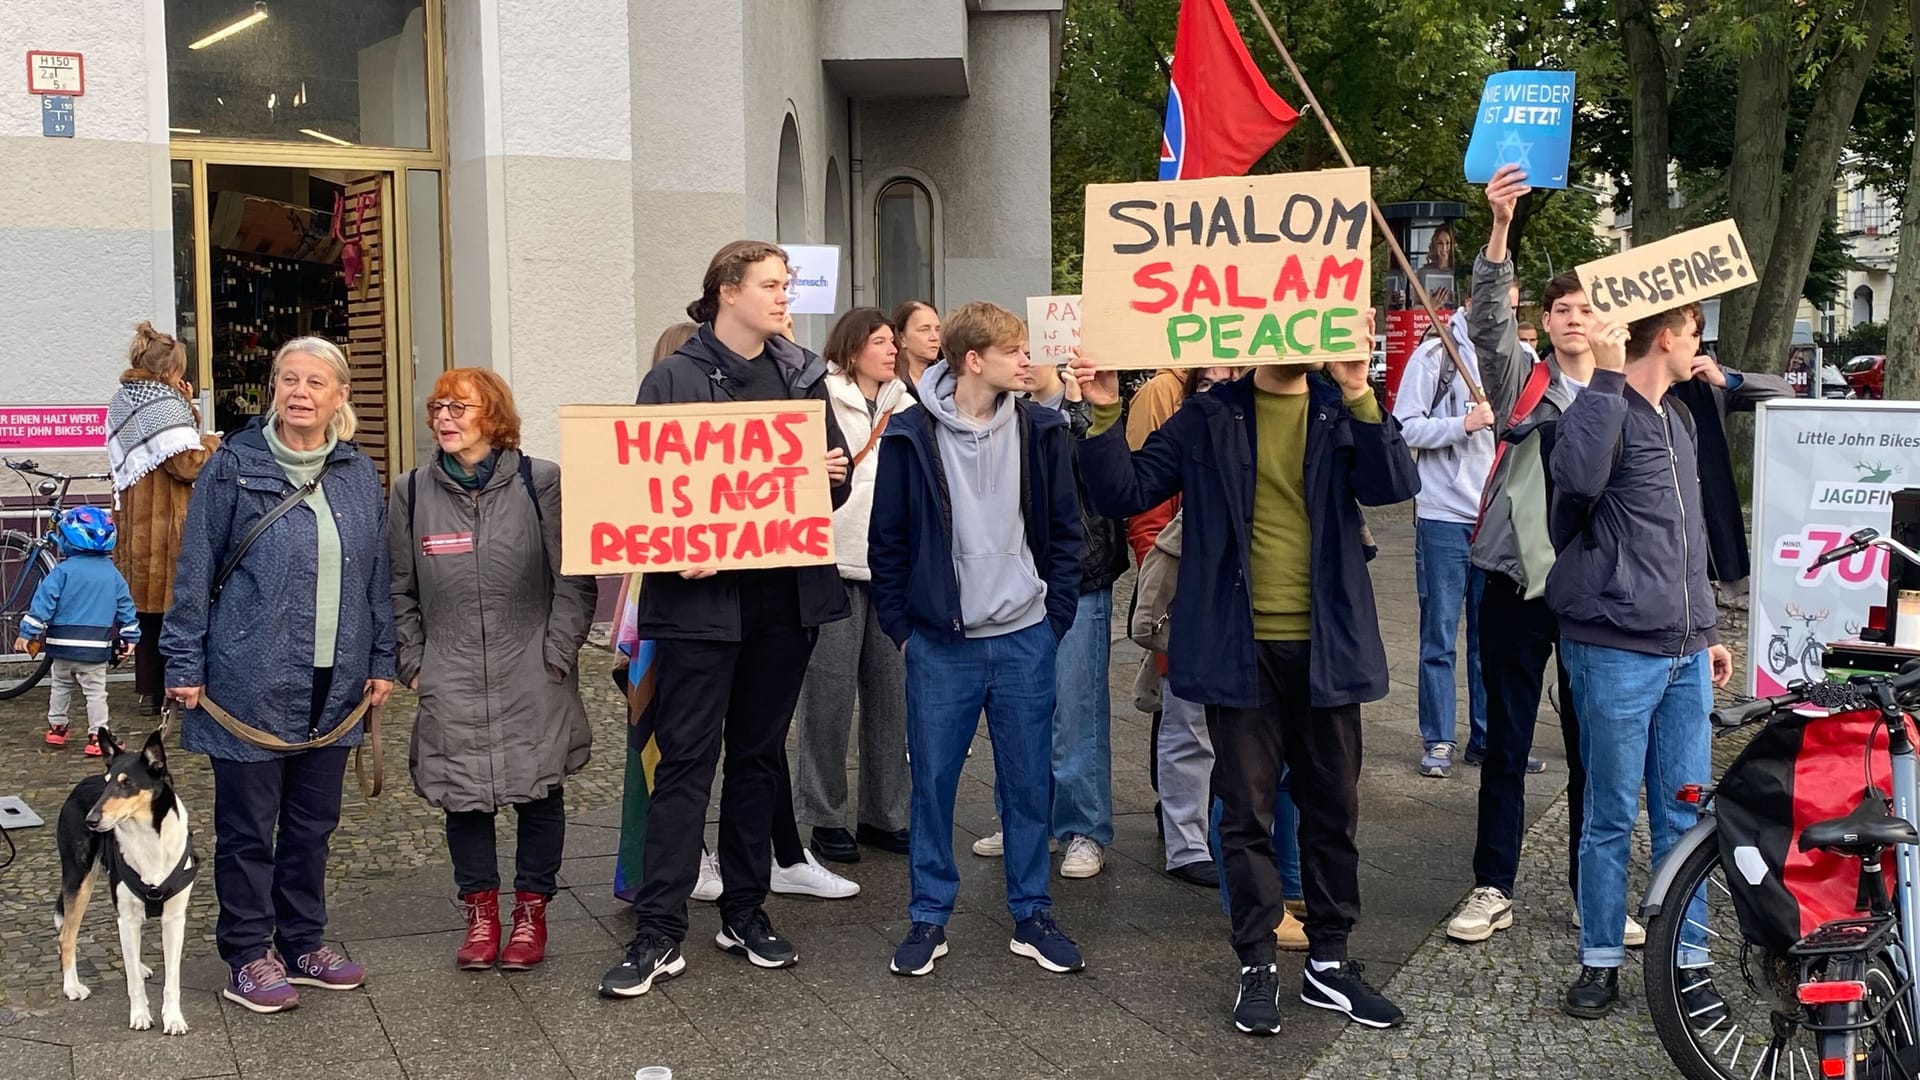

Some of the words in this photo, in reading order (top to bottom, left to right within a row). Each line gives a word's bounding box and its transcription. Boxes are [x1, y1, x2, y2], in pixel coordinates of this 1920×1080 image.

[1484, 85, 1502, 103] NIE
[1503, 84, 1571, 103] WIEDER
[1483, 106, 1503, 124] IST
[1503, 106, 1561, 126] JETZT!
[1108, 193, 1369, 255] SHALOM
[794, 275, 829, 288] ensch
[1591, 233, 1748, 313] CEASEFIRE!
[1129, 253, 1364, 314] SALAM
[1046, 302, 1080, 321] RA
[1043, 330, 1059, 340] IS
[1166, 307, 1358, 360] PEACE
[1041, 344, 1075, 359] RESI
[10, 414, 40, 425] EINEN
[43, 414, 67, 424] HALT
[69, 413, 100, 424] WERT:
[27, 426, 52, 438] JOHN
[54, 426, 82, 437] BIKES
[614, 411, 809, 466] HAMAS
[1797, 431, 1836, 446] Little
[1838, 432, 1875, 447] John
[1879, 433, 1920, 448] Bikes
[648, 475, 693, 518] IS
[709, 466, 809, 515] NOT
[590, 516, 831, 566] RESISTANCE
[1780, 530, 1889, 584] -70
